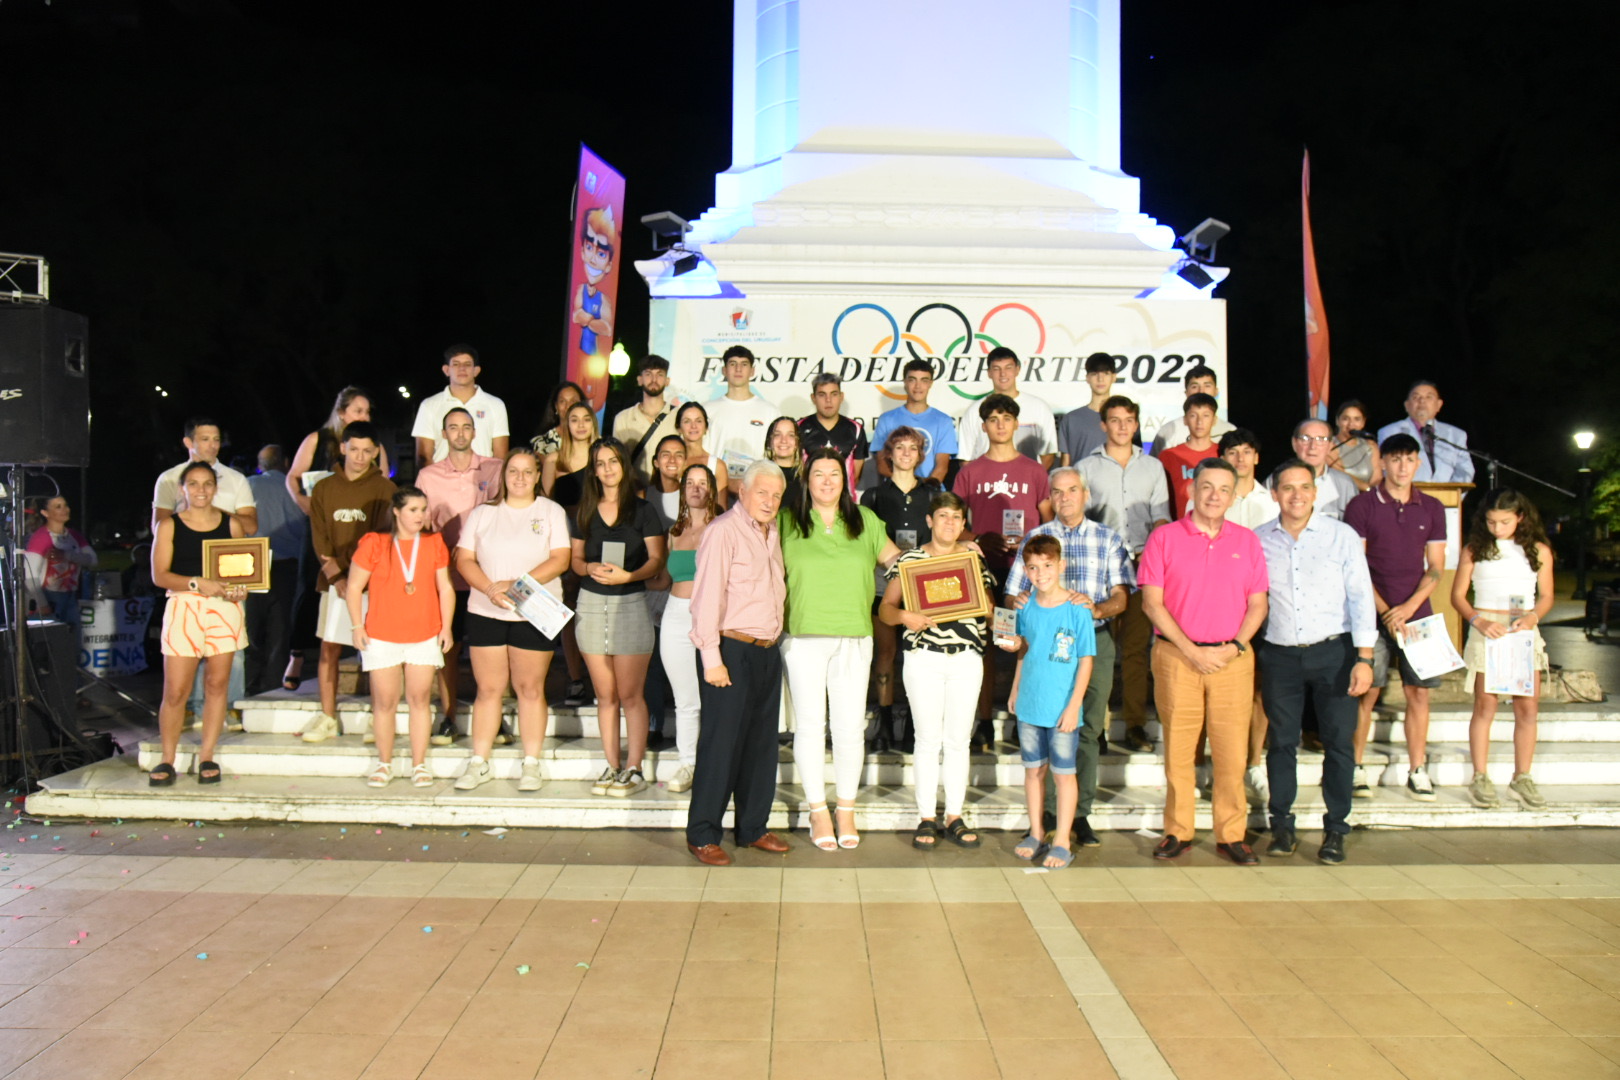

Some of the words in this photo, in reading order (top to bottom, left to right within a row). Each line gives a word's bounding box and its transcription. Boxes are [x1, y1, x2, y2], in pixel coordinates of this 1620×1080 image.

[696, 356, 824, 383] FSTA
[925, 356, 1087, 383] DERTE
[976, 481, 1029, 494] JORDAN
